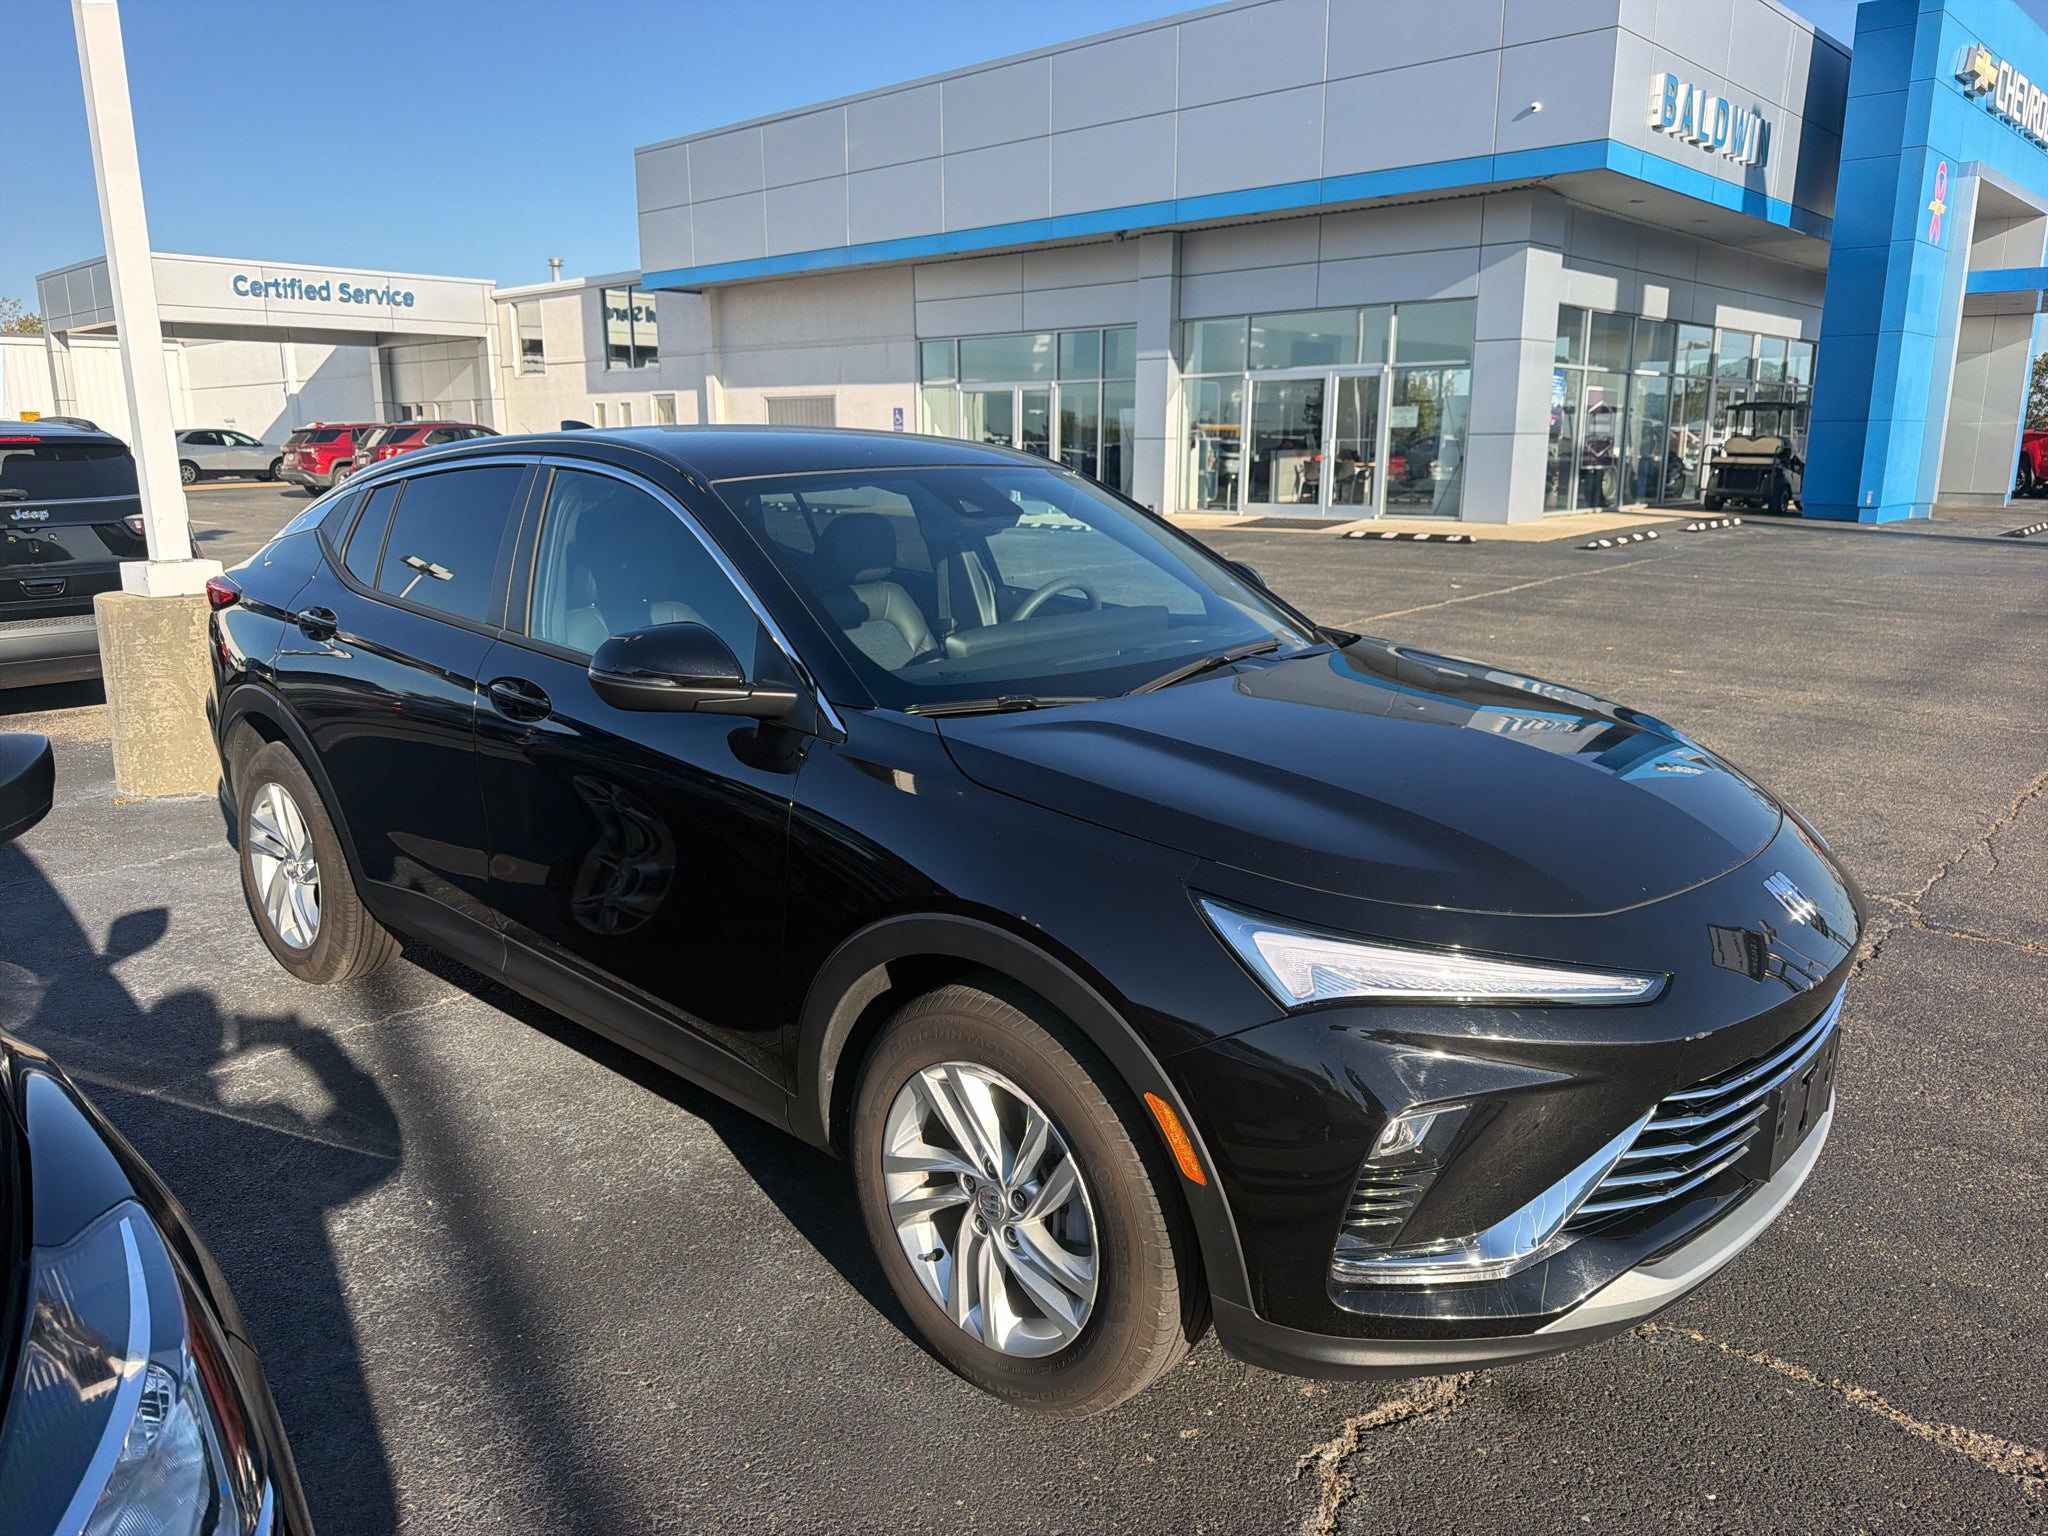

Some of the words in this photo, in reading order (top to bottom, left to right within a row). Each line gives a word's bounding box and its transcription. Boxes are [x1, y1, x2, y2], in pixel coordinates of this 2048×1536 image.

[1659, 72, 1771, 167] BALDWIN
[232, 274, 331, 302] Certified
[337, 282, 415, 307] Service
[10, 509, 49, 521] Jeep
